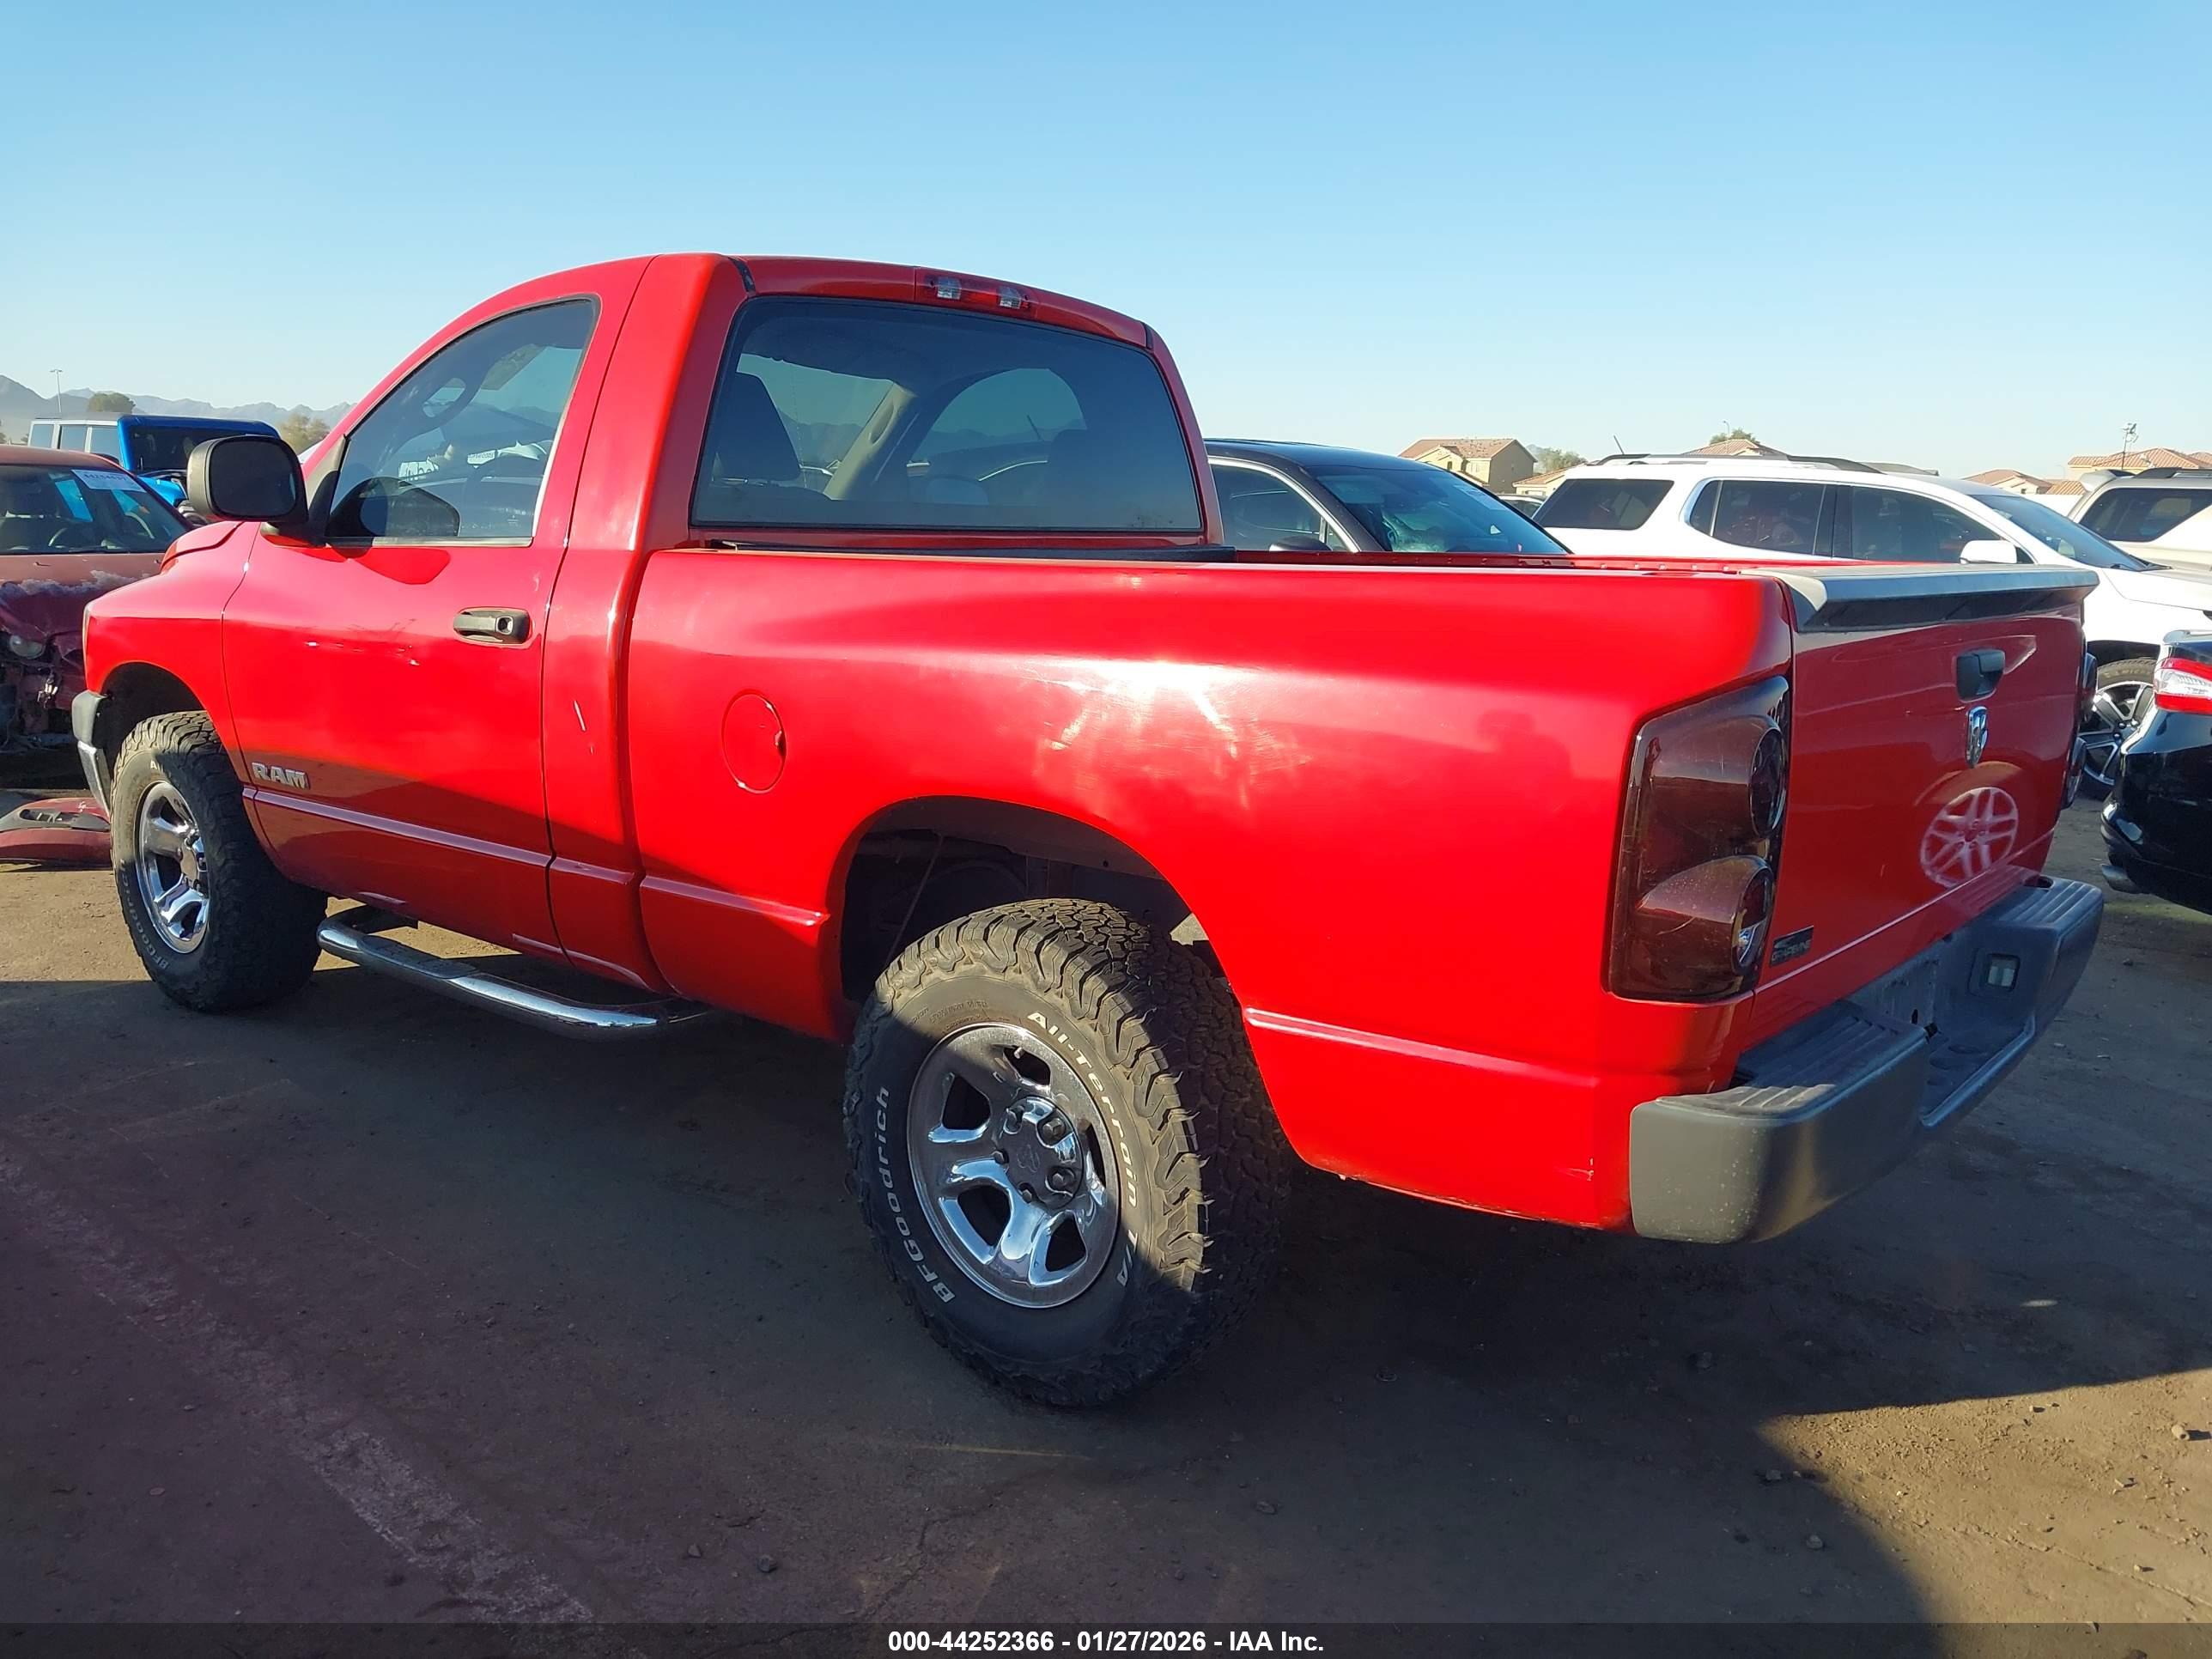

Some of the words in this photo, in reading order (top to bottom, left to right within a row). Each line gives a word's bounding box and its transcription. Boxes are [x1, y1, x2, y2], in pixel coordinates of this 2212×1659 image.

[252, 762, 310, 789] RAM
[873, 1086, 956, 1304] BFGoodrich
[1027, 1011, 1139, 1208] All-Terrain
